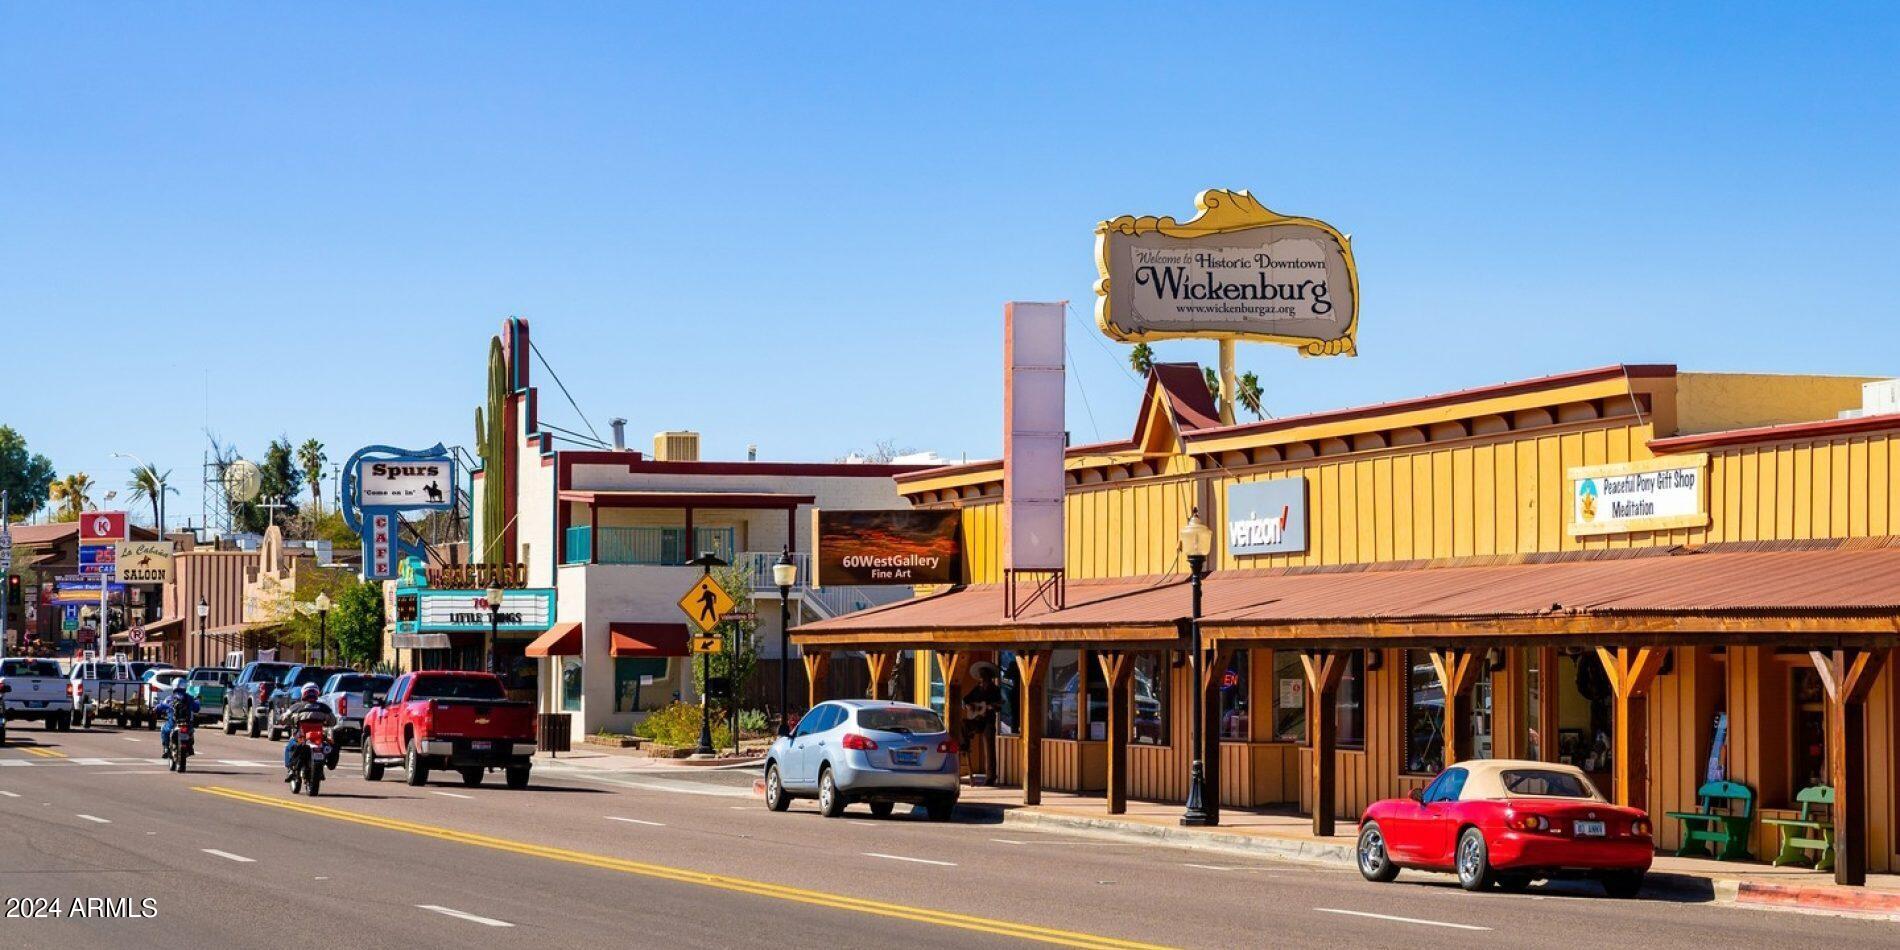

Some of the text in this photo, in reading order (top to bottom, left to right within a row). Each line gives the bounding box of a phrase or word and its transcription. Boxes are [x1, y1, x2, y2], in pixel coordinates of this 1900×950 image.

[1136, 251, 1326, 269] Welcome to Historic Downtown
[1135, 266, 1332, 315] Wickenburg
[1176, 302, 1296, 316] www.wickenburgaz.org
[372, 463, 439, 480] Spurs
[1603, 469, 1695, 495] Peaceful Pony Gift Shop
[1611, 499, 1654, 518] Meditation
[1229, 511, 1282, 547] verizon
[121, 546, 132, 558] La
[375, 516, 388, 574] CAFE
[842, 553, 939, 569] 60WestGallery
[123, 569, 166, 580] SALOON
[871, 568, 912, 579] Fine Art
[449, 612, 483, 623] LITTLE
